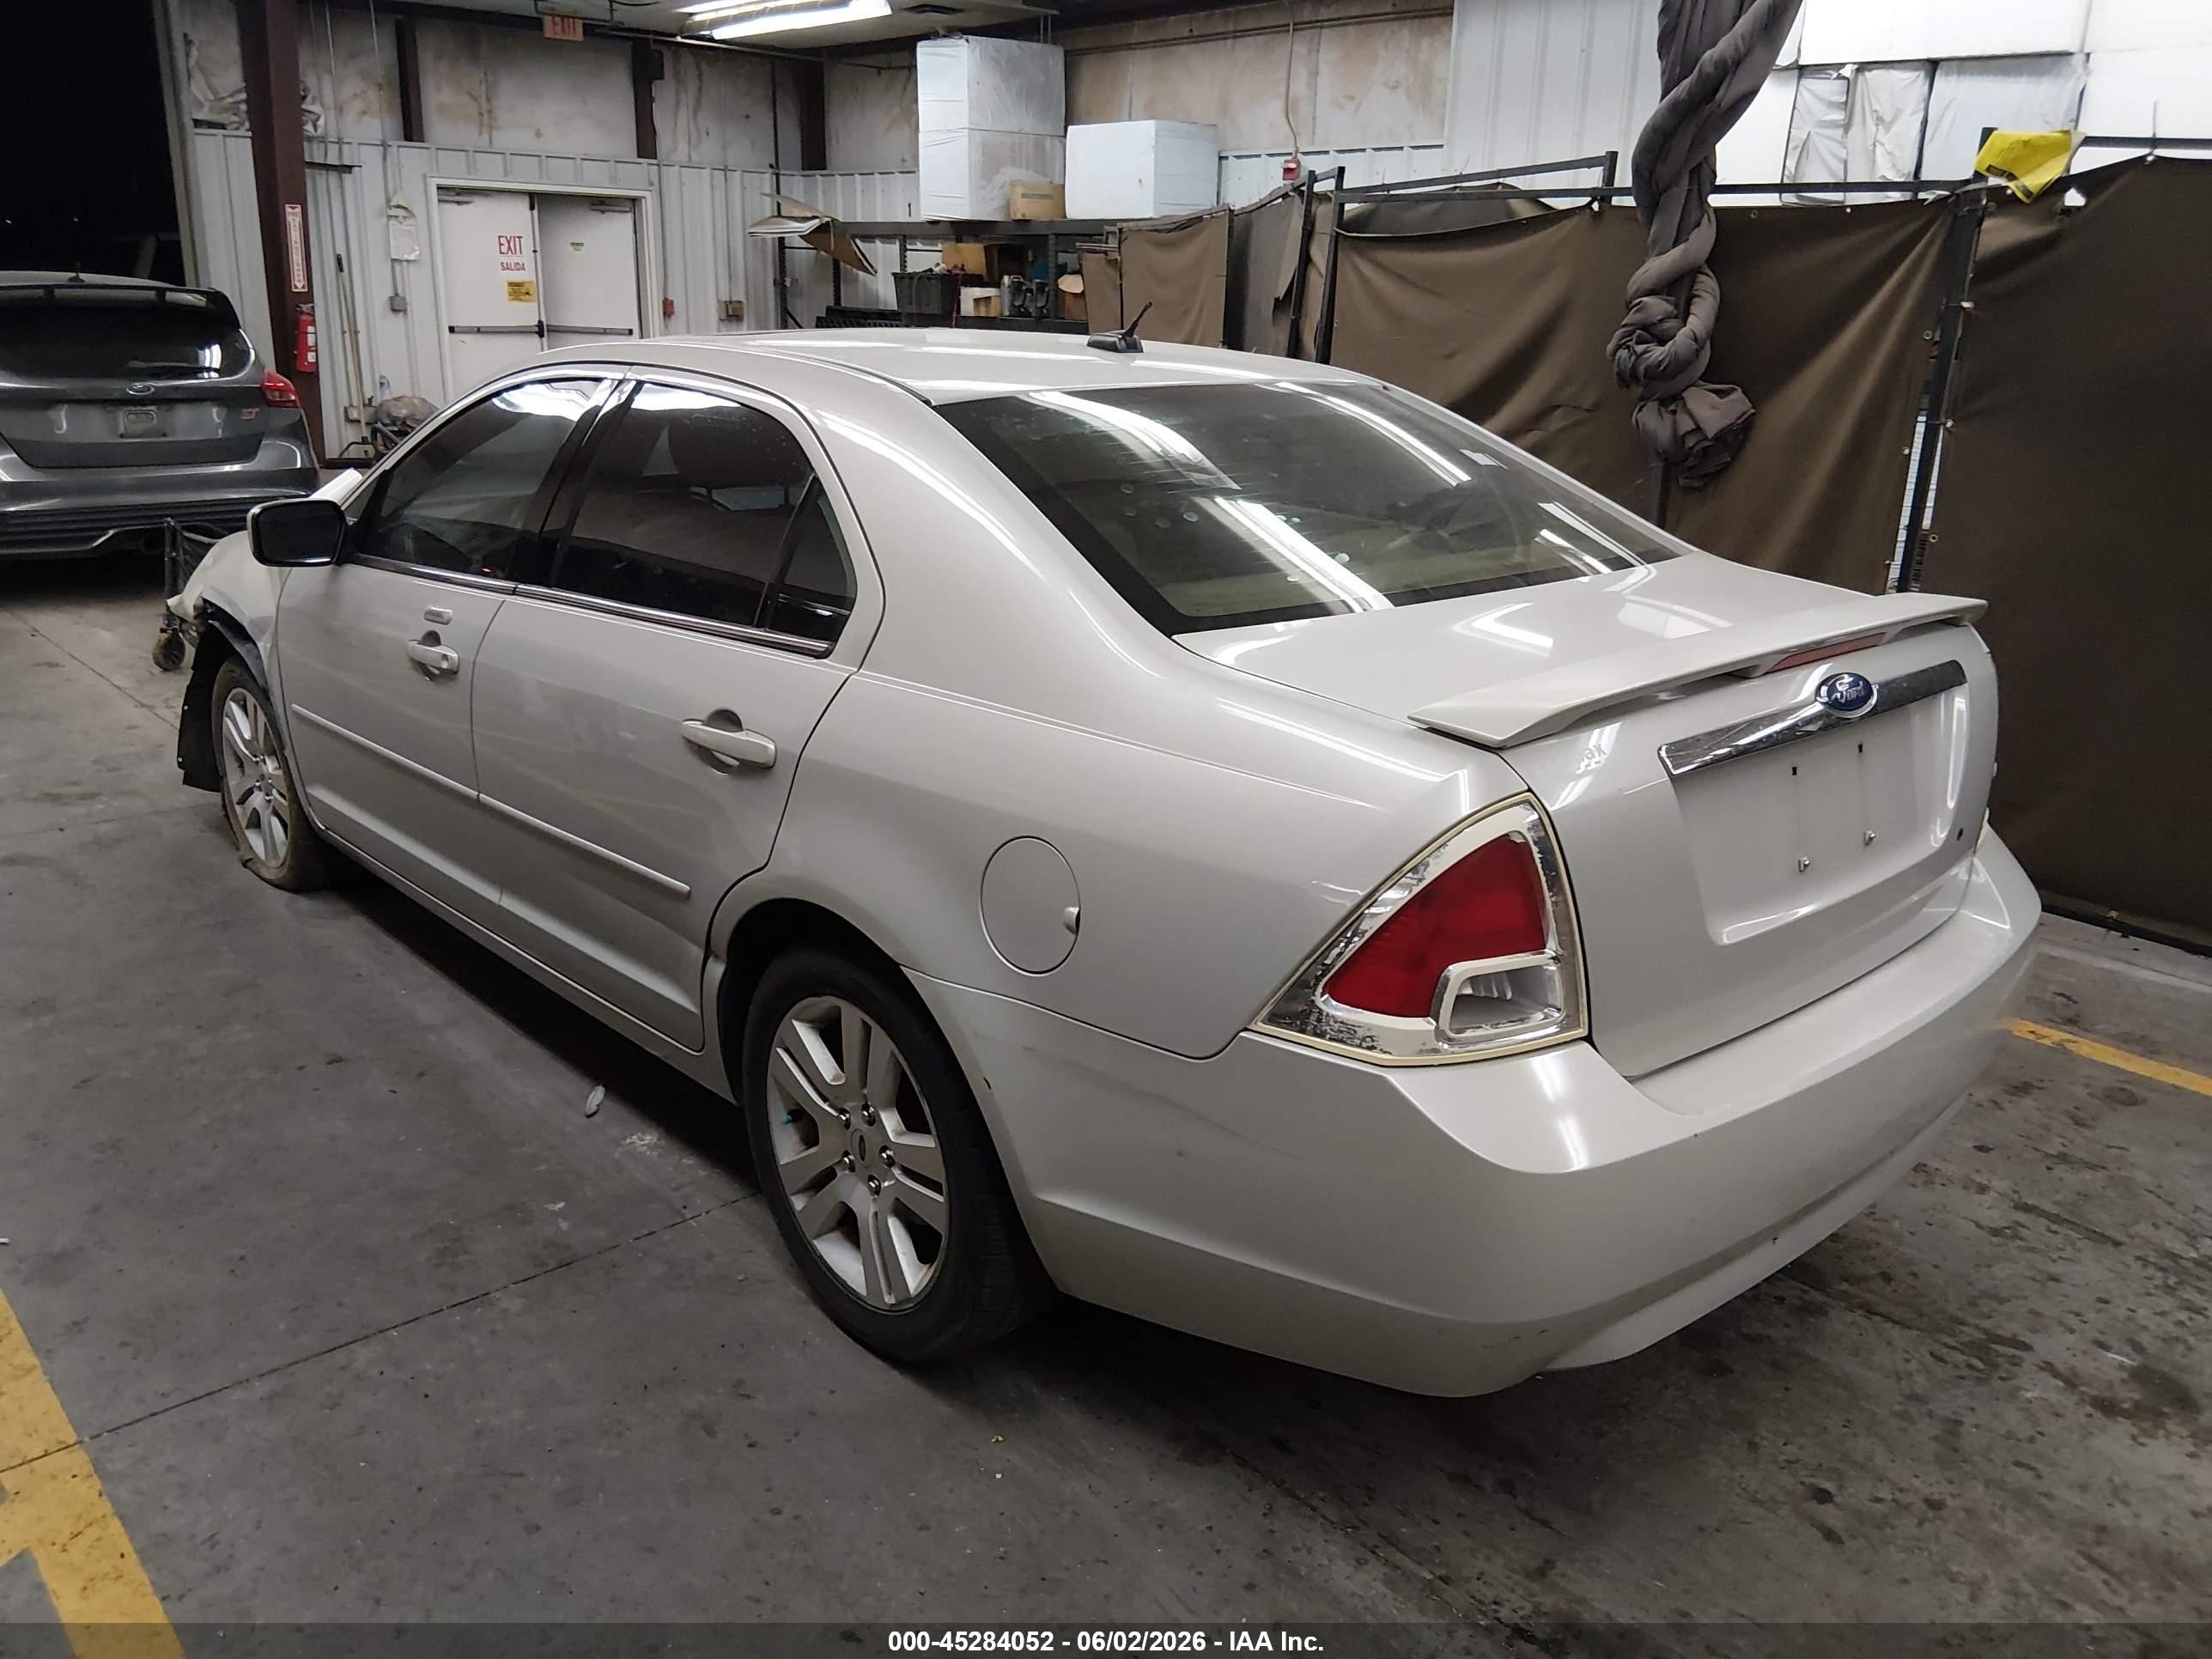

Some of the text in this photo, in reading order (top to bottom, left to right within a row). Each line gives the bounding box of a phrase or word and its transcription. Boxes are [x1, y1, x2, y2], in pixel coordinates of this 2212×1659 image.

[550, 16, 577, 37] EXIT
[498, 234, 523, 255] EXIT
[501, 261, 526, 271] SALIDA
[1828, 674, 1864, 703] Ford
